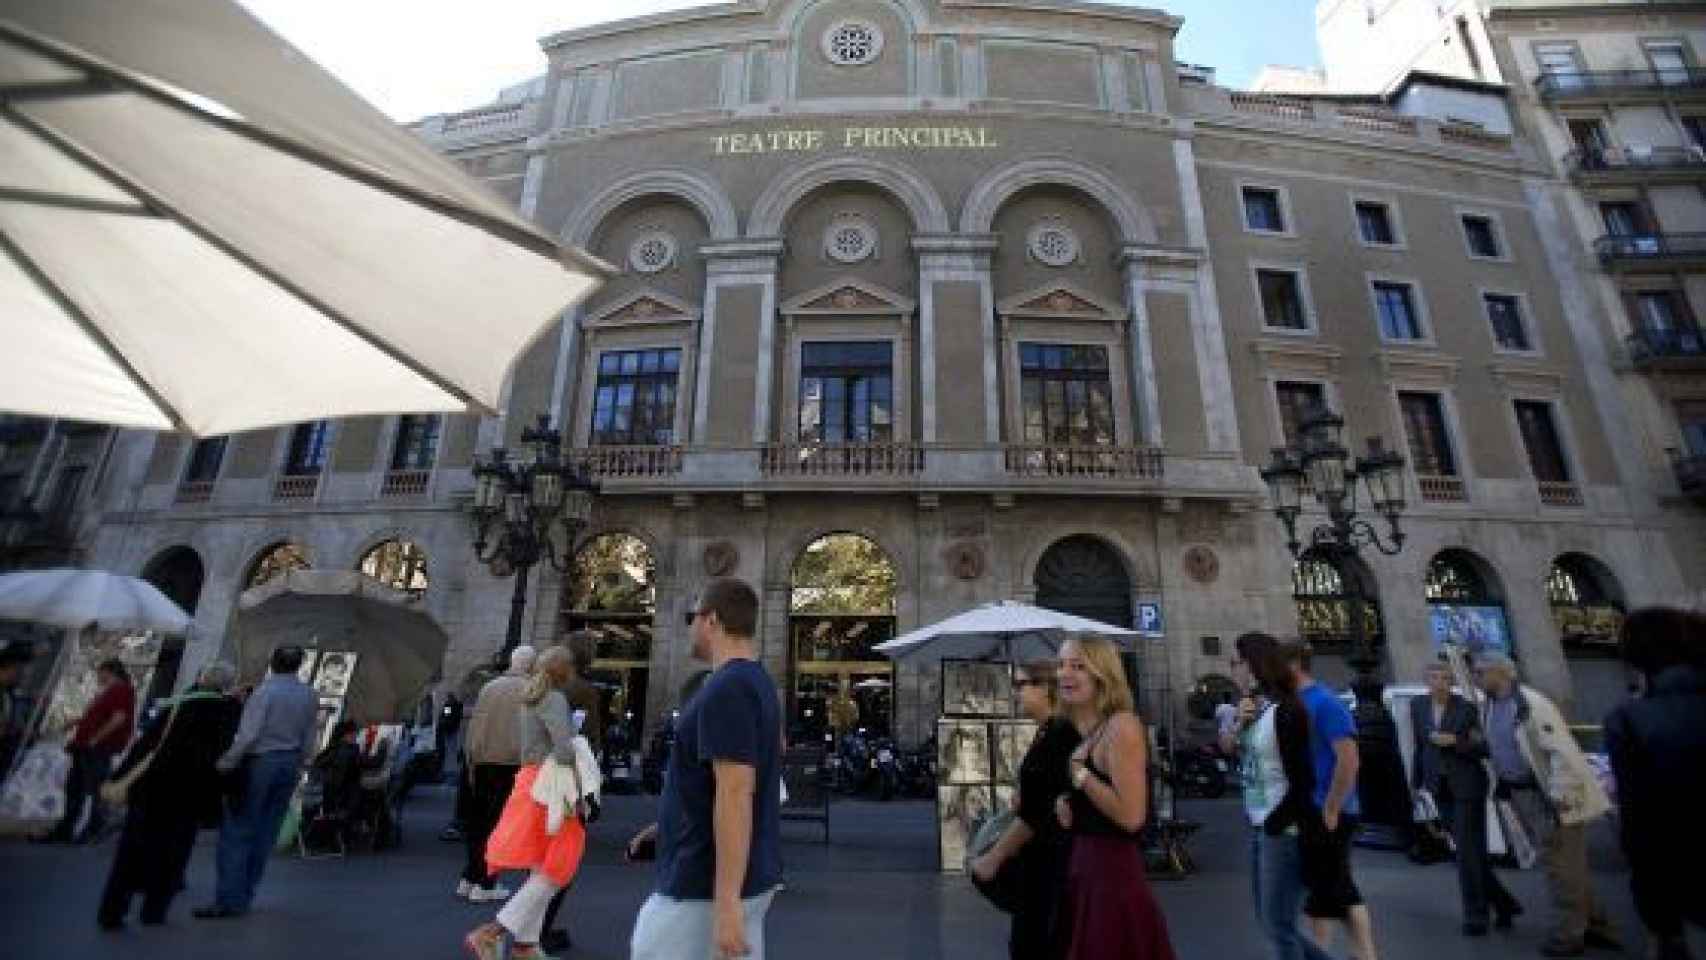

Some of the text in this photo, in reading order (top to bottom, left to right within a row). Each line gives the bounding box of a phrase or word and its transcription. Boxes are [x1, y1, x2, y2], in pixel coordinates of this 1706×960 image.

[710, 127, 998, 154] TEATRE PRINCIPAL
[1141, 605, 1156, 629] P
